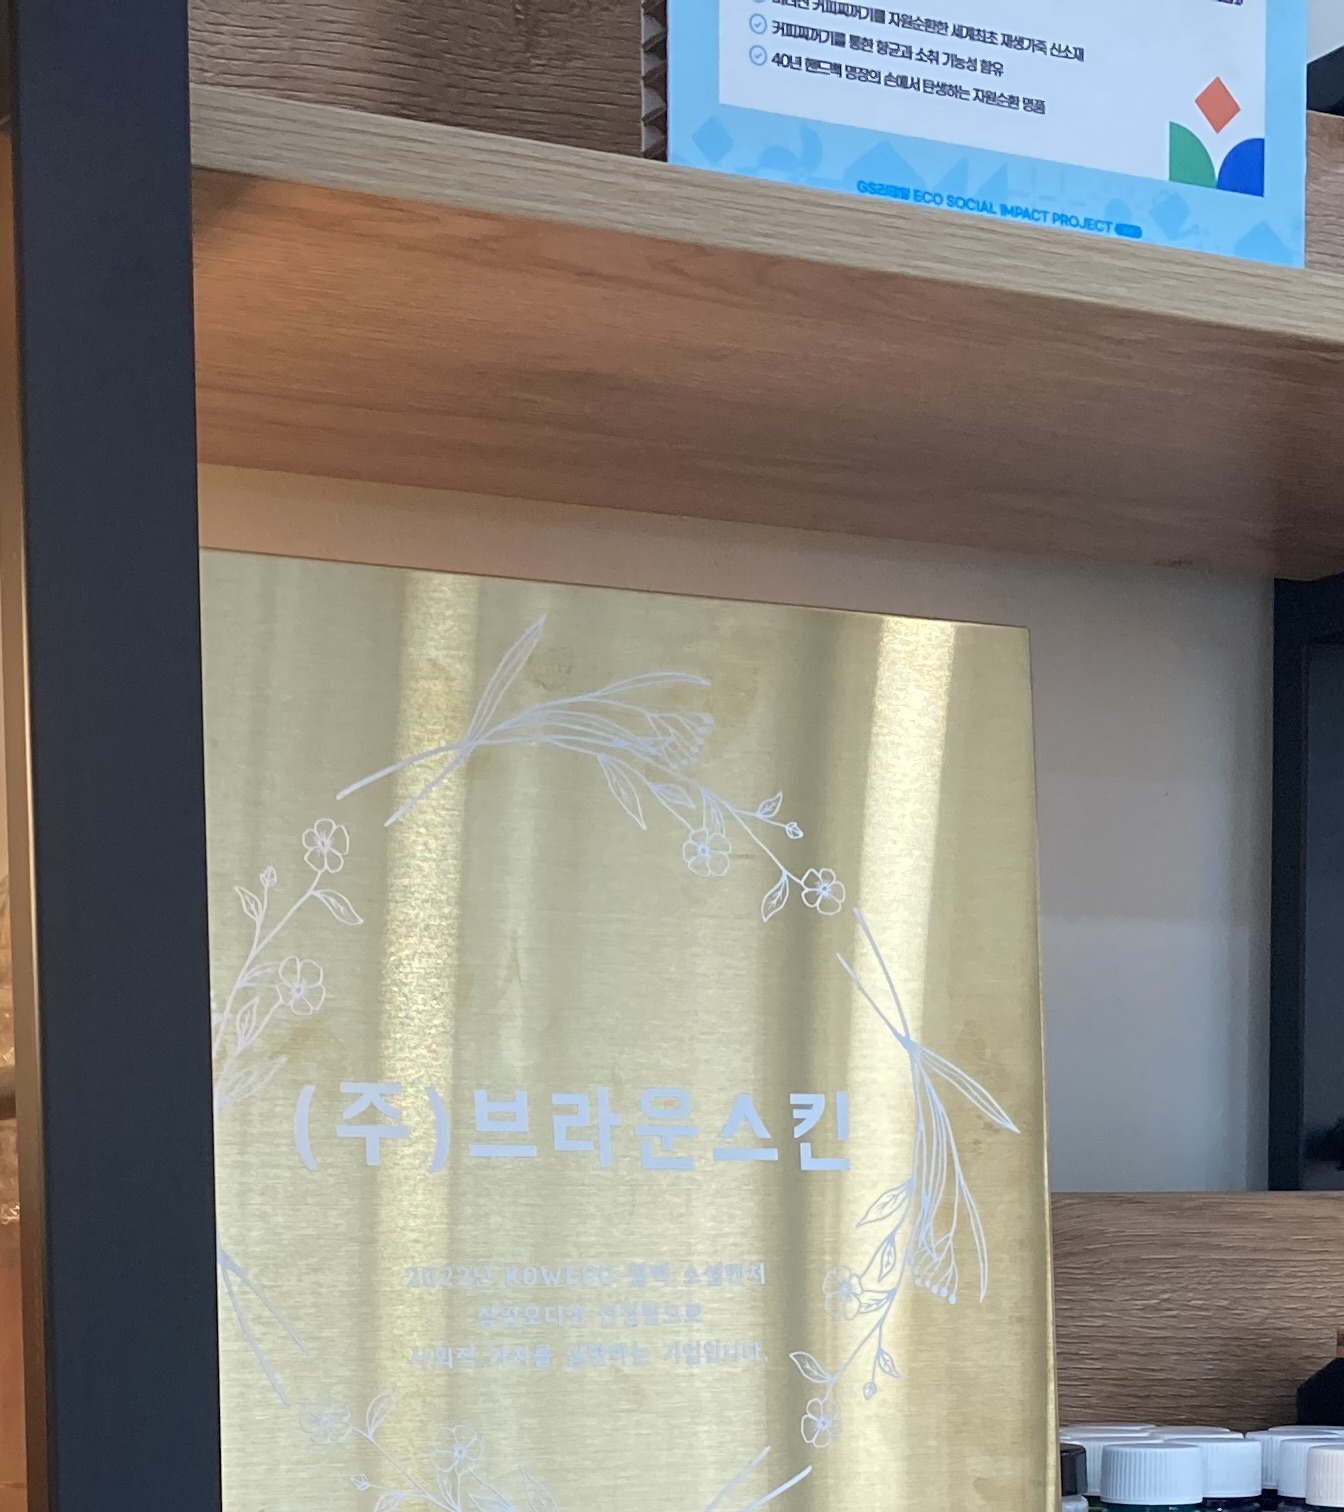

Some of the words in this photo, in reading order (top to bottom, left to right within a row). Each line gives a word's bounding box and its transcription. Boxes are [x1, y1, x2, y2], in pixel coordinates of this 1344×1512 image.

[849, 34, 874, 53] 통한
[915, 48, 939, 66] 소취
[942, 51, 977, 72] 기능성
[980, 59, 1004, 77] 함유
[888, 10, 949, 36] 자원순환한
[951, 23, 998, 45] 세계최초
[1000, 32, 1048, 55] 재생가죽
[1050, 42, 1085, 62] 신소재
[771, 52, 802, 71] 40년
[805, 57, 842, 78] 핸드백
[844, 64, 882, 84] 명장의
[884, 72, 920, 92] 손에서
[923, 78, 970, 101] 탄생하는
[972, 87, 1020, 110] 자원순환
[1022, 96, 1046, 115] 명품
[913, 188, 944, 206] ECO
[946, 195, 997, 215] SOCIAL
[999, 203, 1050, 223] IMPACT
[1052, 211, 1114, 233] PROJECT
[295, 1080, 852, 1174] (주)브라운스킨
